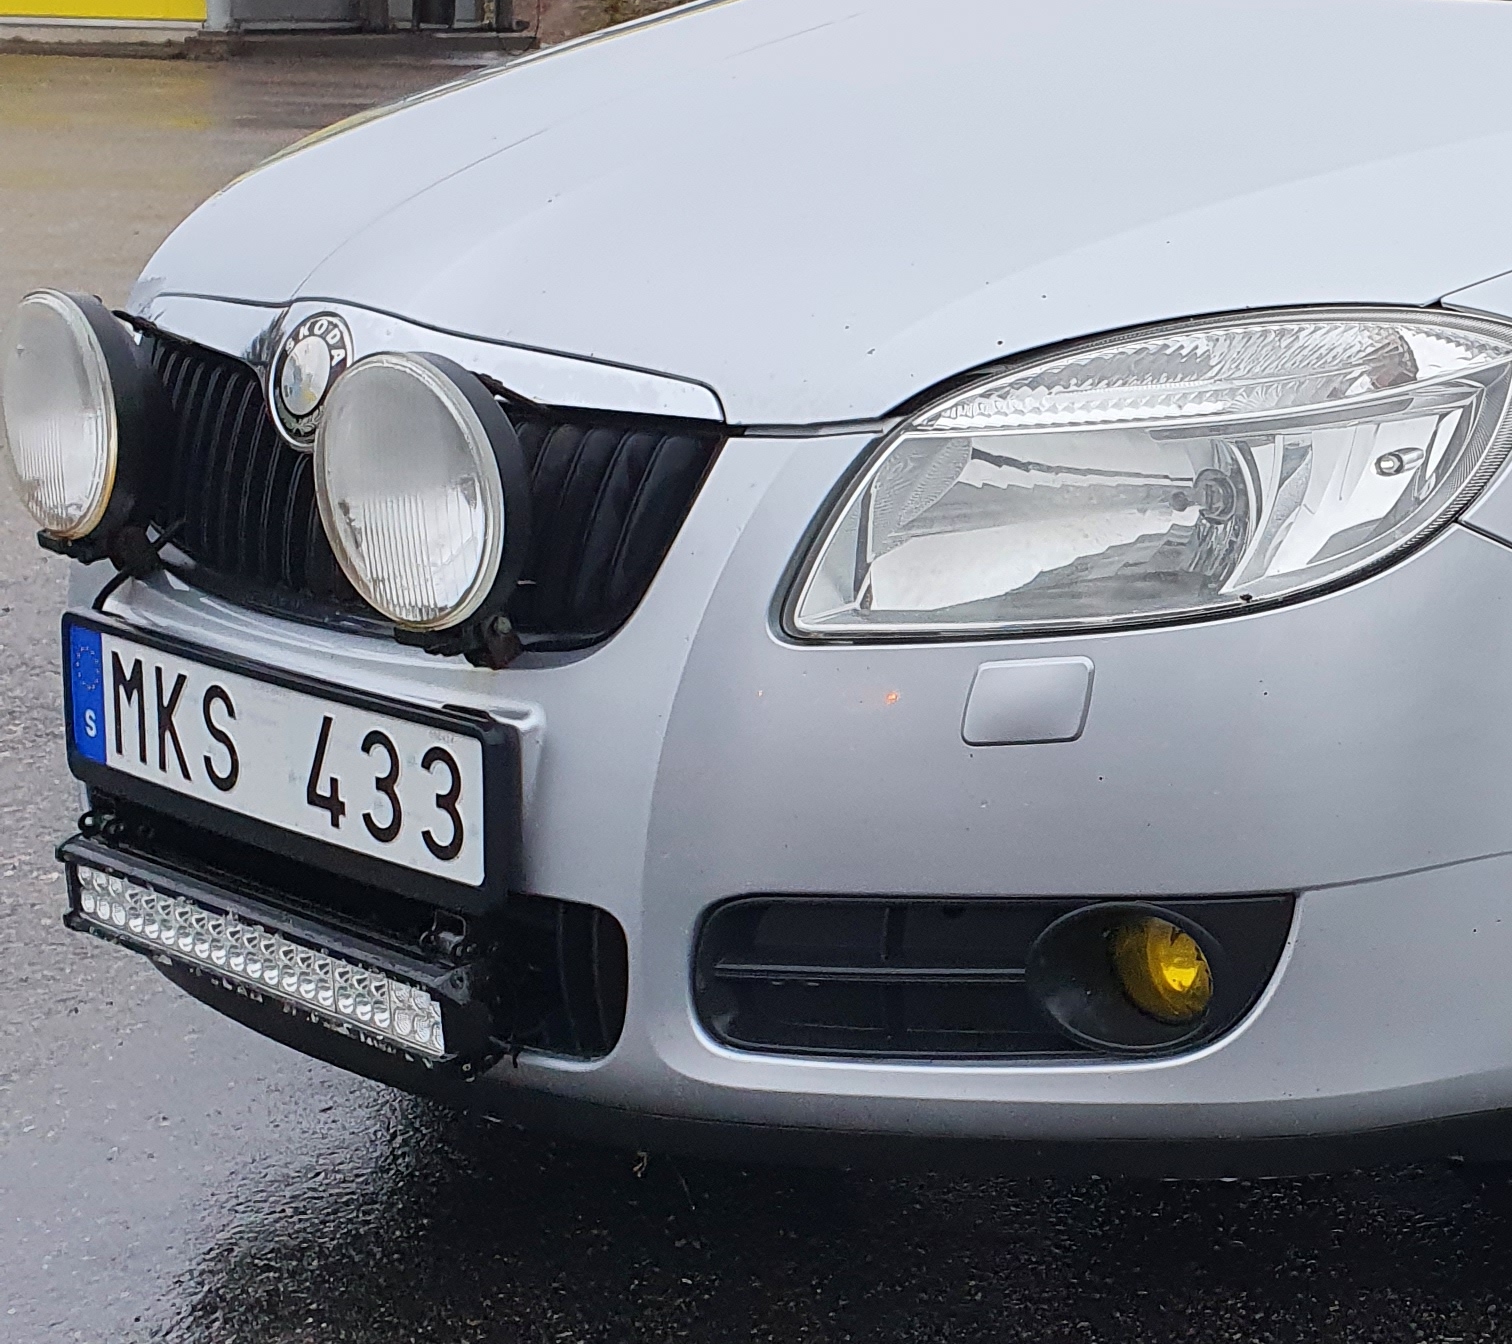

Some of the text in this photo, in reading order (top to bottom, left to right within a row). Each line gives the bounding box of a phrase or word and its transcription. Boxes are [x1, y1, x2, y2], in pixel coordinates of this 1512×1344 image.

[85, 709, 97, 738] S
[111, 650, 465, 862] MKS 433
